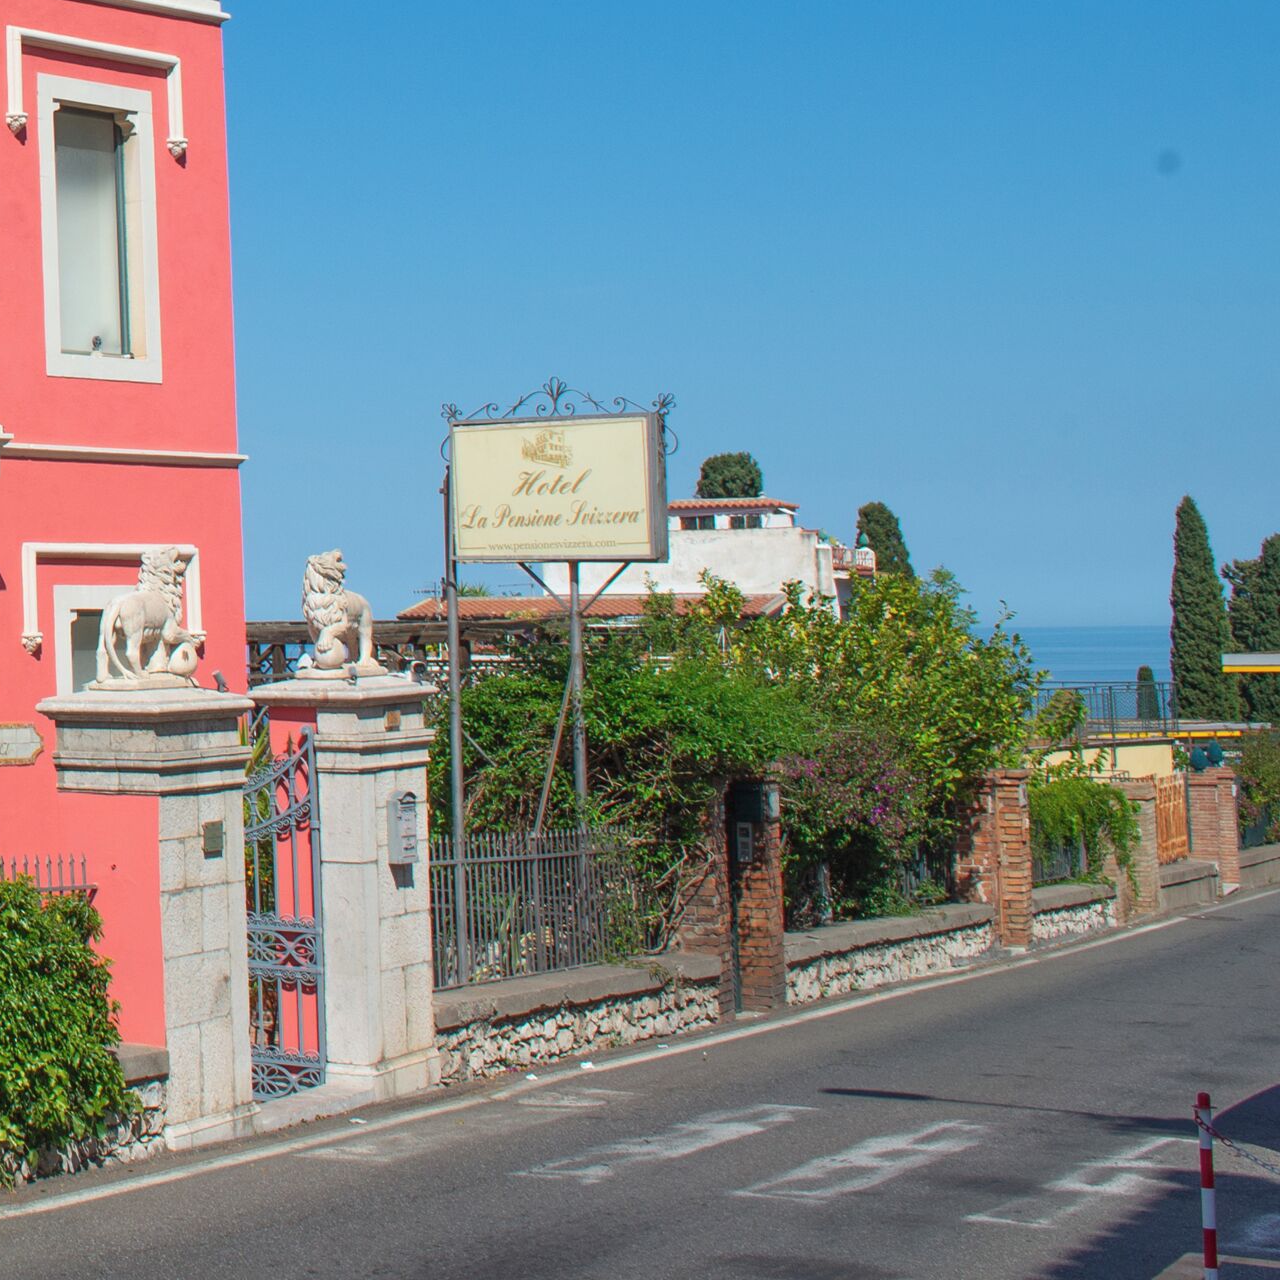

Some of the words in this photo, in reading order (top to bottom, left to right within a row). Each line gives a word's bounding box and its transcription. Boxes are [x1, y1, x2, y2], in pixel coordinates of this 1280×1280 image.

[511, 468, 592, 497] Hotel
[491, 503, 562, 529] Pensione
[488, 538, 617, 553] www.pensionesvizzera.com
